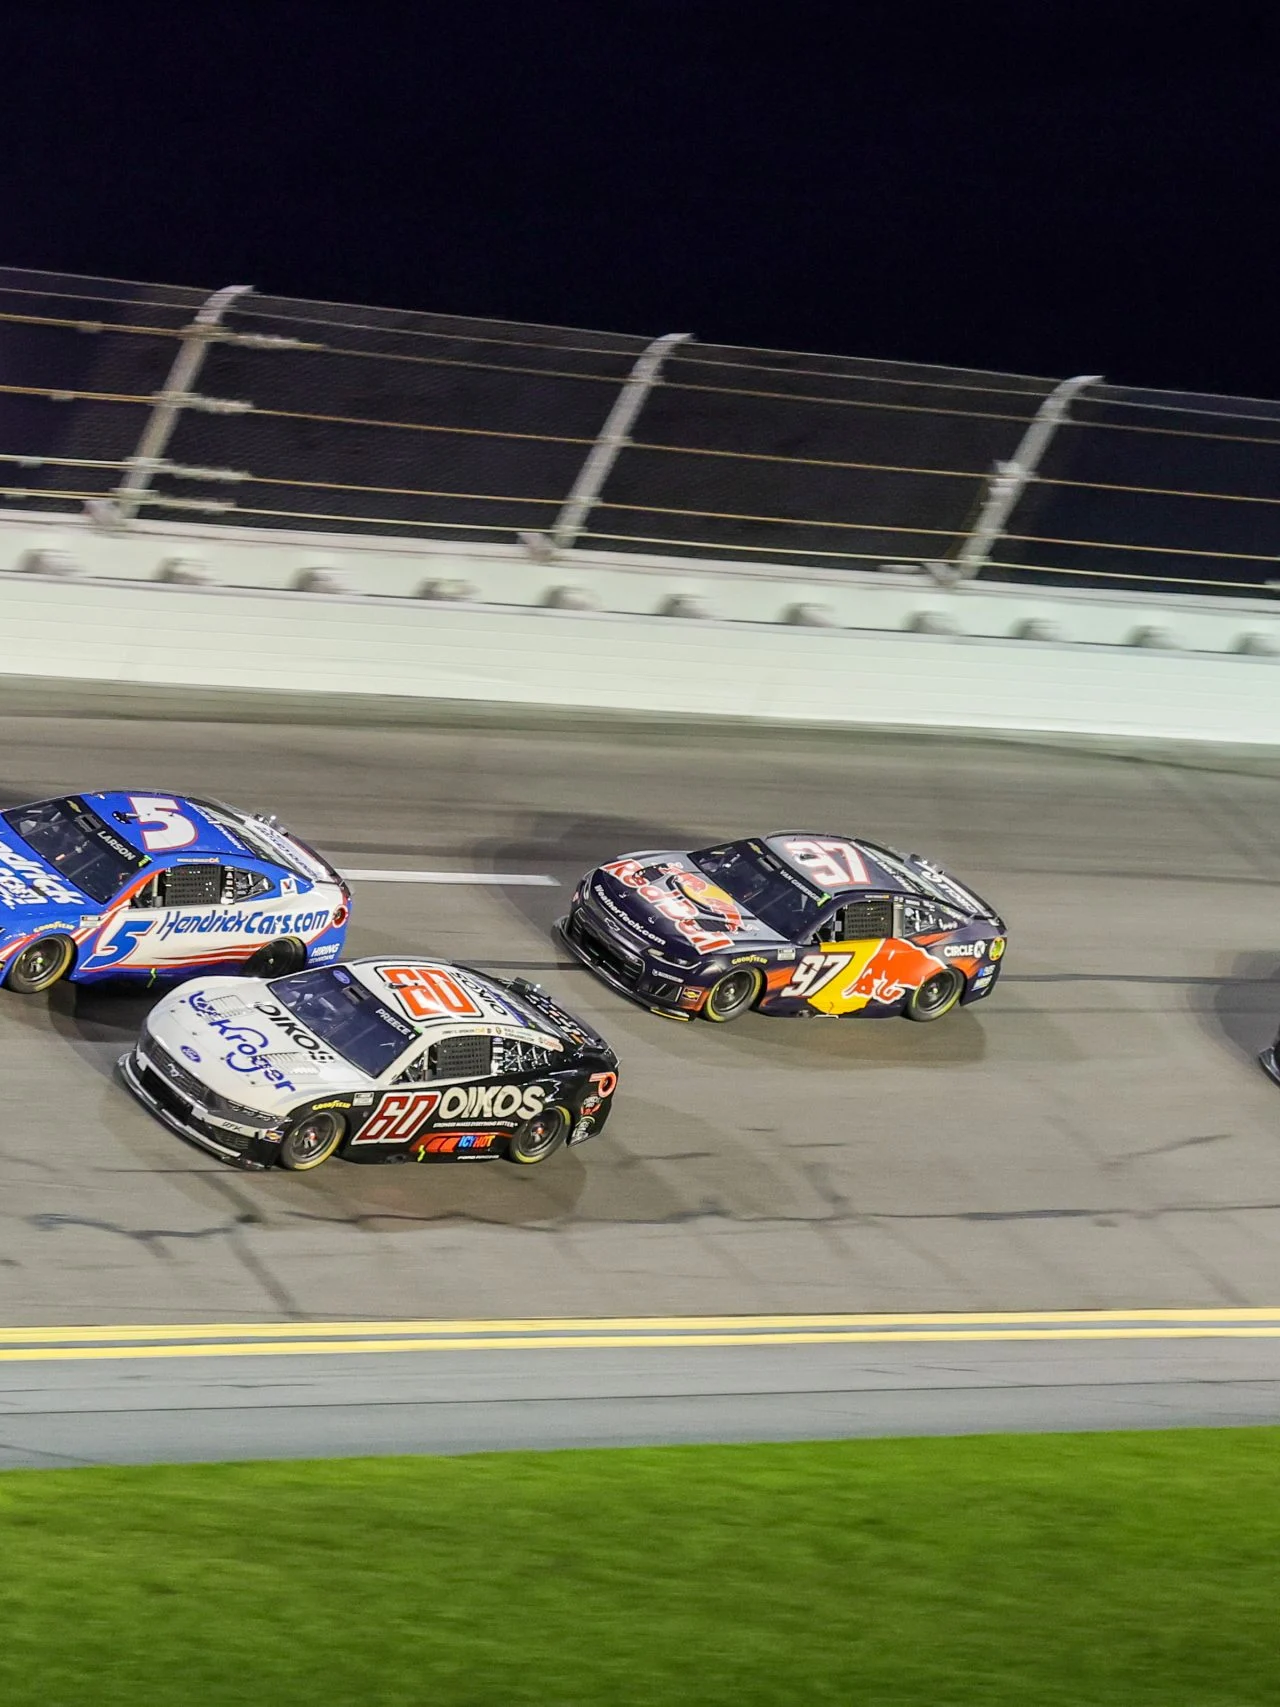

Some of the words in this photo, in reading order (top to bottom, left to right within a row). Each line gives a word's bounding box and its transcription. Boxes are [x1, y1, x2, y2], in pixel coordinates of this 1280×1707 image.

[128, 796, 197, 851] 5
[96, 830, 136, 861] LARSON
[784, 841, 870, 886] 97
[791, 879, 822, 902] GISBERGE
[156, 909, 330, 941] HendrickCars.com
[594, 884, 666, 946] WeatherTech.com
[80, 919, 157, 970] 5
[311, 942, 340, 957] HIRING
[731, 954, 769, 966] GOODYEAR
[943, 944, 974, 957] CIRCLE
[382, 967, 477, 1018] 60
[780, 954, 854, 998] 97
[253, 1001, 336, 1064] OIKOS
[375, 1008, 412, 1038] PREECE
[208, 1019, 297, 1092] Kroger
[312, 1100, 352, 1111] GOODYEAR
[352, 1091, 441, 1145] 60
[438, 1085, 546, 1120] OIKOS
